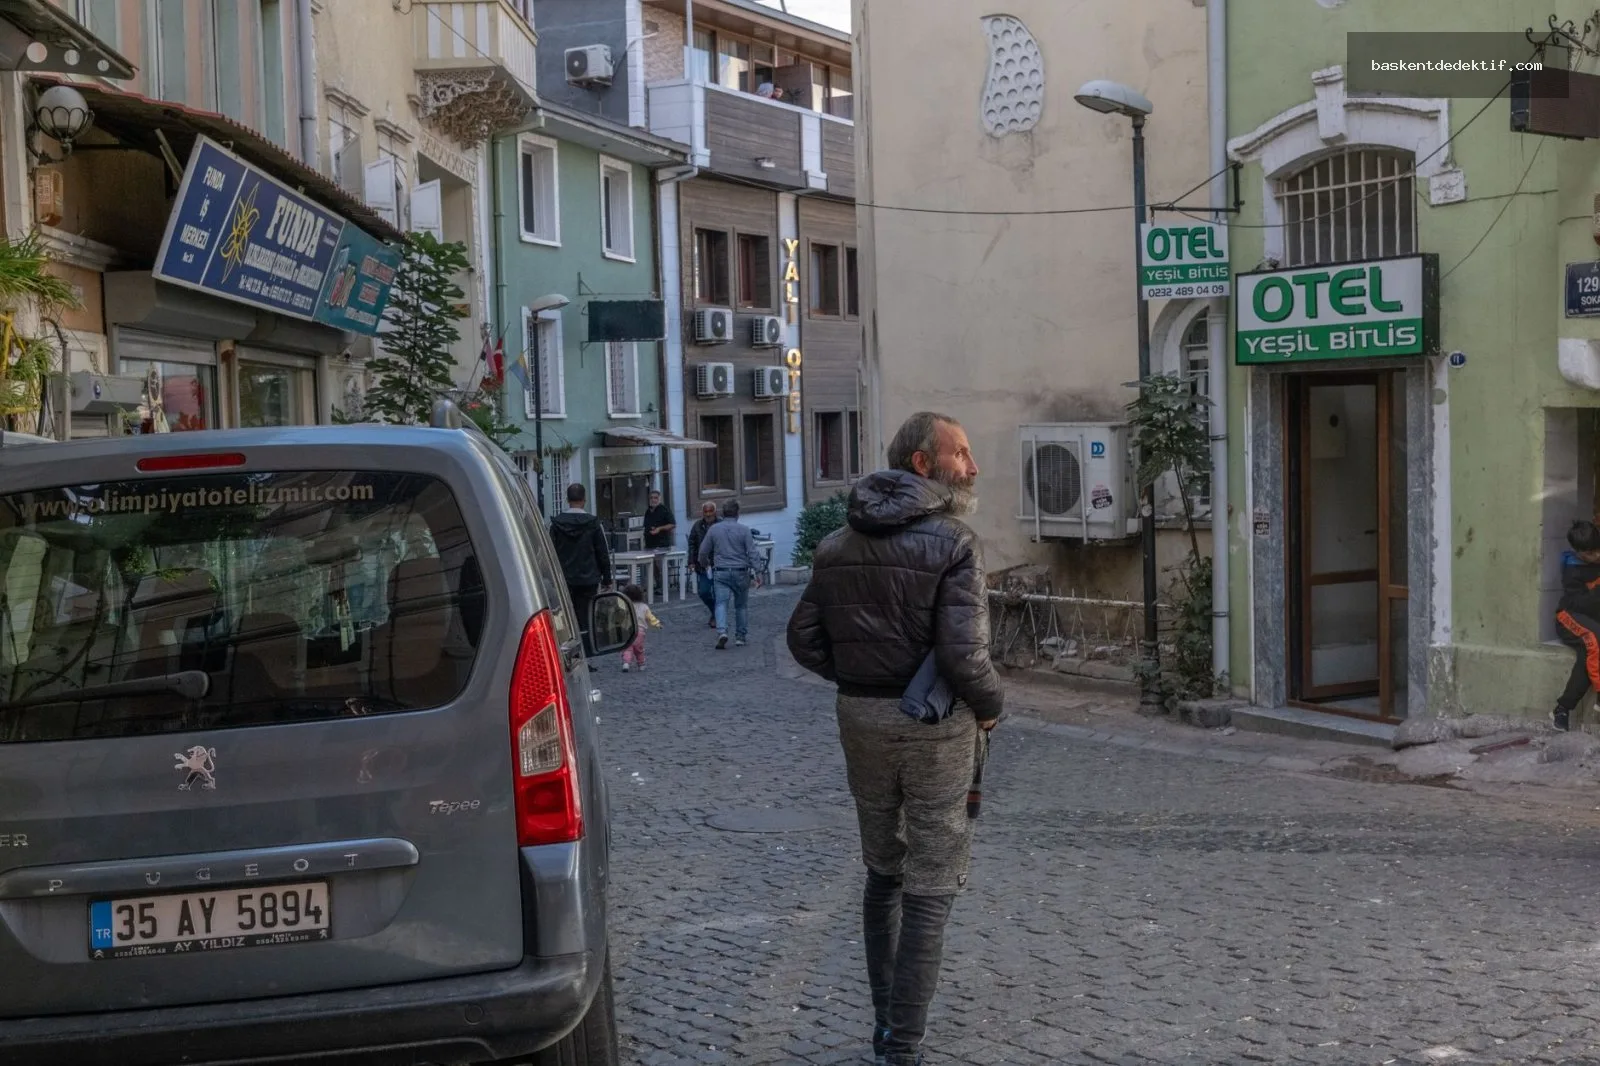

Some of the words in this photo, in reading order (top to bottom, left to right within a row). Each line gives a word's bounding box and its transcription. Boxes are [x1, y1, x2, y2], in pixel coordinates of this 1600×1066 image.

[203, 166, 226, 192] FUNDA
[265, 194, 325, 258] FUNDA
[1147, 226, 1224, 261] OTEL
[1146, 267, 1184, 282] YEŞİL
[1188, 265, 1228, 279] BİTLİS
[1148, 287, 1172, 297] 0232
[1175, 286, 1194, 296] 489
[1196, 285, 1209, 295] 04
[1211, 284, 1224, 294] 09
[1252, 266, 1403, 323] OTEL
[1244, 330, 1320, 358] YEŞİL
[1329, 323, 1417, 350] BİTLİS
[19, 482, 374, 516] www.olimpiyatotelizmir.com
[430, 799, 481, 816] Tepee
[116, 902, 158, 941] 35
[177, 896, 216, 936] AY
[237, 889, 323, 931] 5894
[95, 928, 111, 939] TR
[174, 940, 192, 953] AY
[200, 936, 246, 950] YILDIZ
